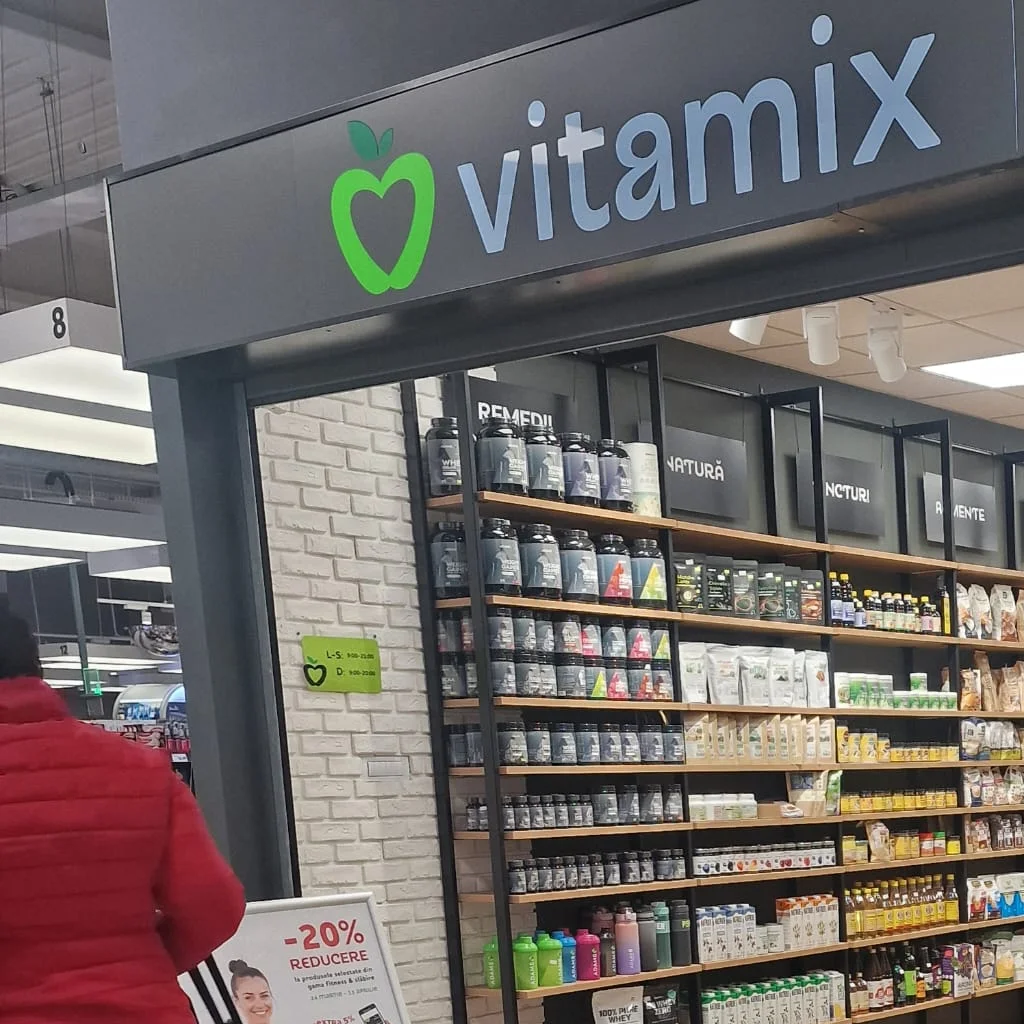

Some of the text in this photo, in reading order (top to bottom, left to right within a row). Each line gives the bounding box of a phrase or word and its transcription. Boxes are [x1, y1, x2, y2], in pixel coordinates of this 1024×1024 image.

[457, 14, 942, 254] vitamix
[52, 307, 66, 339] 8
[813, 481, 870, 503] NCTURI
[935, 501, 985, 521] AMENTE
[60, 645, 68, 655] 12
[284, 919, 365, 950] -20%
[289, 949, 369, 970] REDUCERE
[608, 1013, 632, 1023] WHEY
